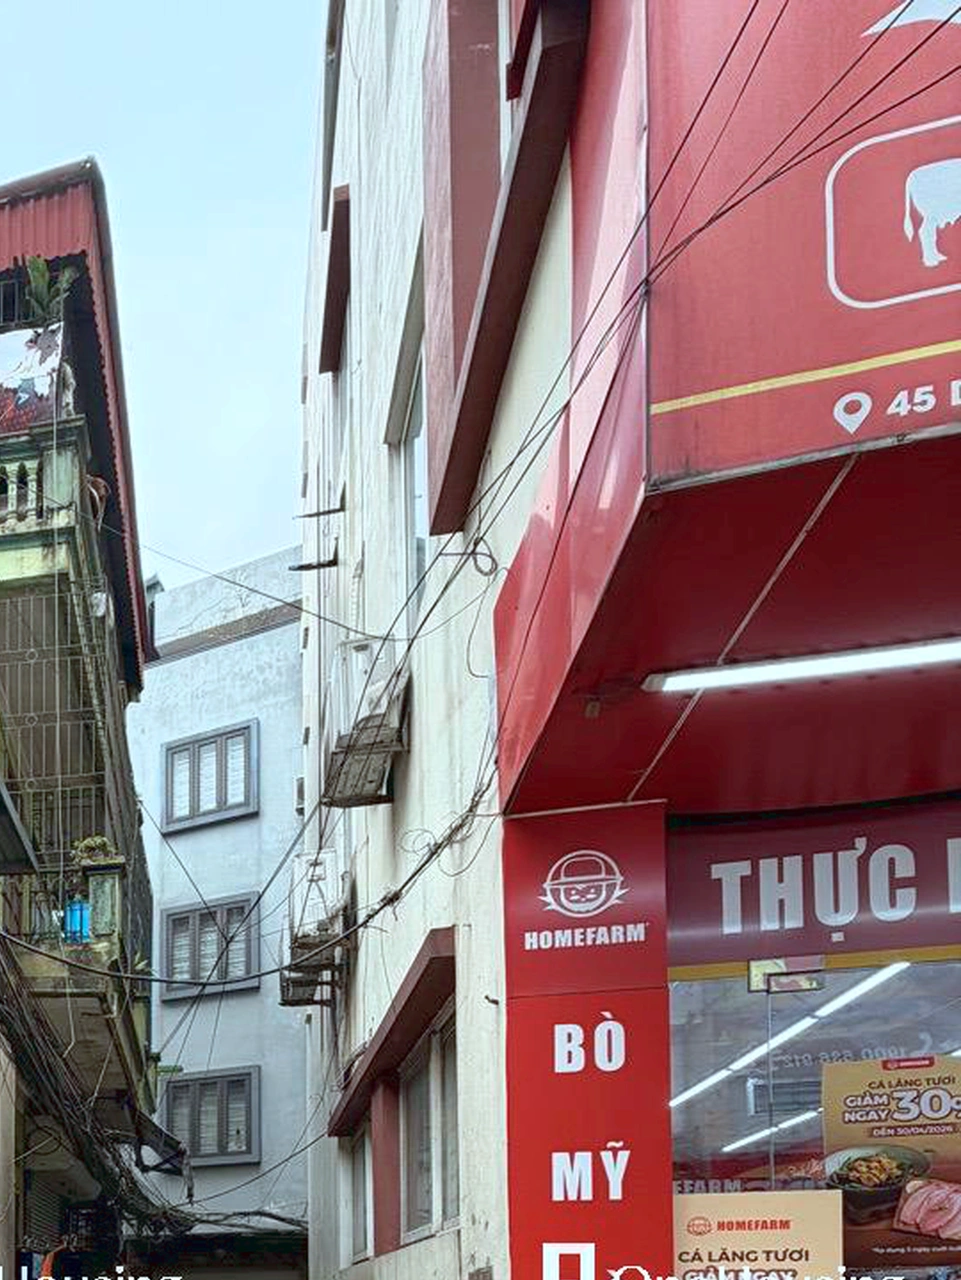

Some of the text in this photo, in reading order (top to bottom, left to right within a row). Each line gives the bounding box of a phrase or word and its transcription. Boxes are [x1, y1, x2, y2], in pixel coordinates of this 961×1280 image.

[887, 385, 936, 416] 45
[711, 837, 917, 942] THỰC
[524, 922, 646, 950] HOMEFARM
[554, 1012, 626, 1073] BÒ
[843, 1109, 889, 1122] NGAY
[551, 1141, 631, 1202] MỸ
[717, 1219, 791, 1231] HOMEFARM
[678, 1248, 809, 1263] CÁ LĂNG TƯƠI
